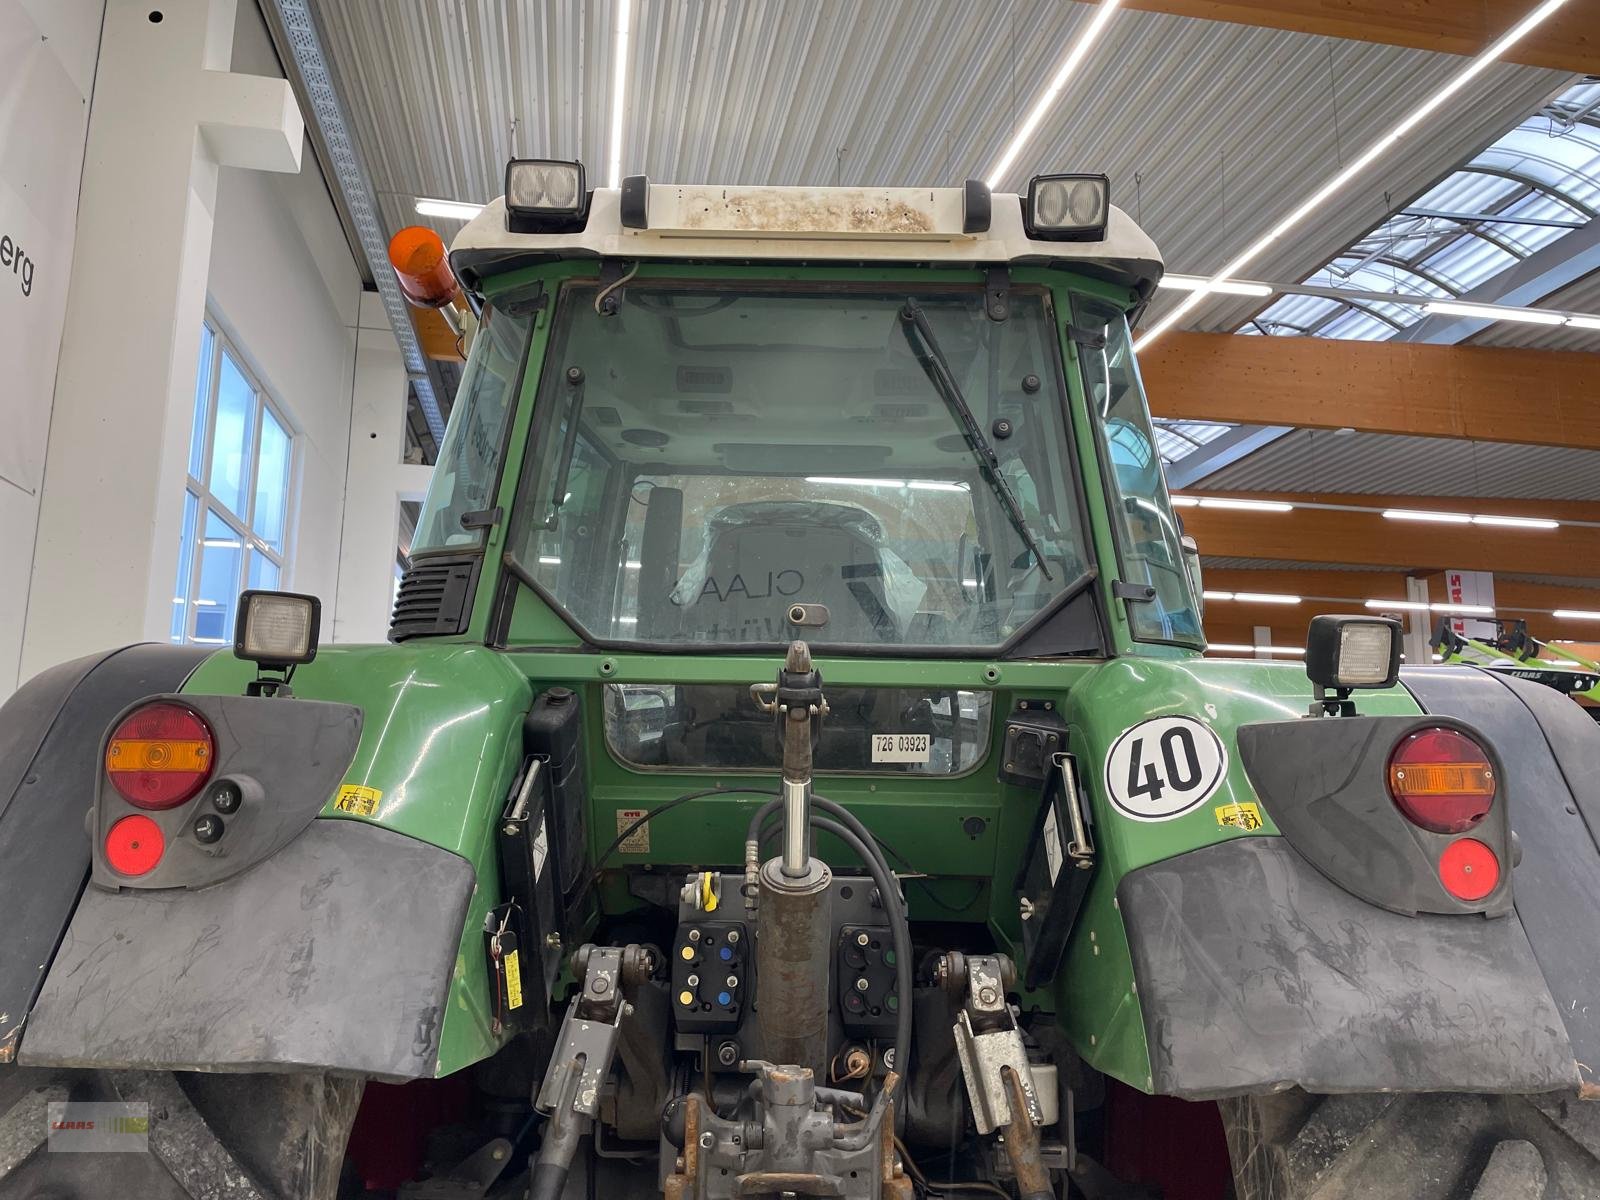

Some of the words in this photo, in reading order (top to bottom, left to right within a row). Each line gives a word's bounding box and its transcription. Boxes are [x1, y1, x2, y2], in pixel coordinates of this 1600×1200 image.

[0, 234, 34, 297] erg
[876, 736, 893, 752] 726
[898, 736, 927, 752] 03923
[1127, 726, 1202, 801] 40
